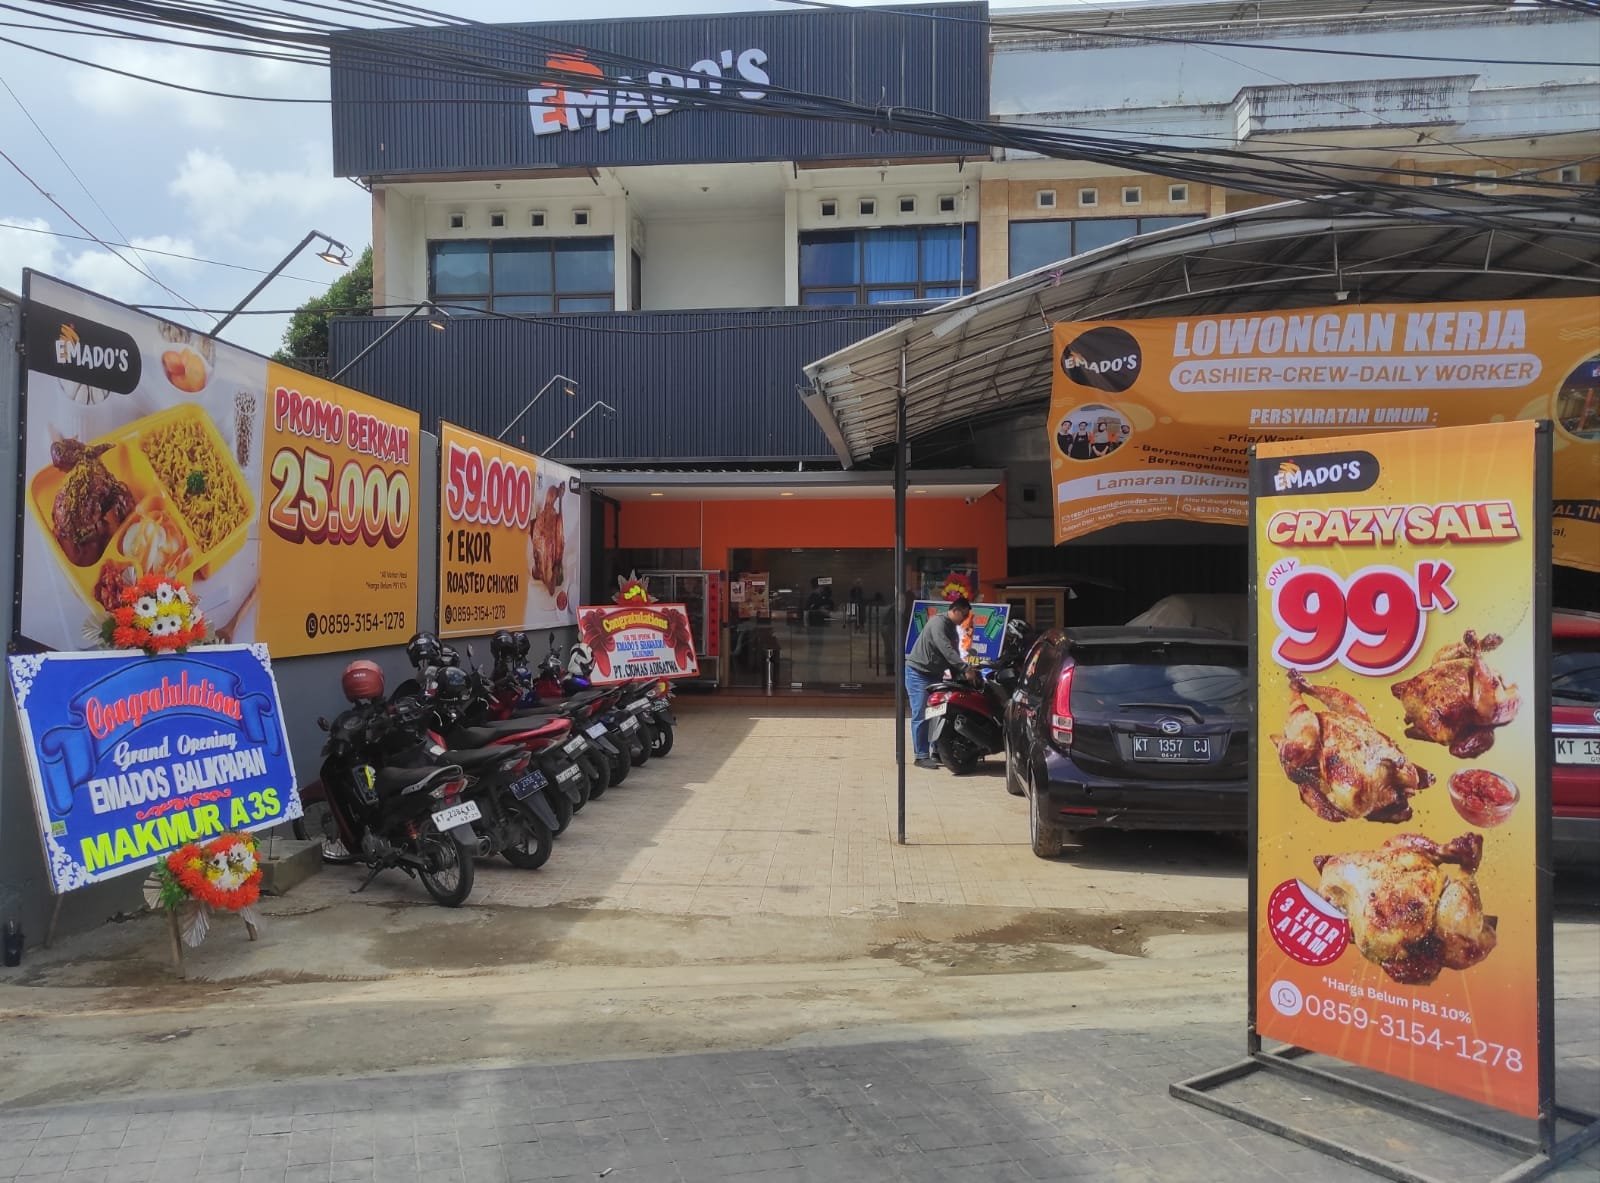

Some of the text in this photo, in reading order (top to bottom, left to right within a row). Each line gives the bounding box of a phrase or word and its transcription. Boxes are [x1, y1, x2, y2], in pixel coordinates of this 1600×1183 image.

[528, 48, 770, 136] EMADO'S
[1173, 309, 1526, 357] LOWONGAN KERJA
[55, 340, 129, 373] EMADO'S
[1065, 354, 1137, 374] EMADO'S
[1178, 361, 1534, 385] CASHIER-CREW-DAILY WORKER
[275, 387, 410, 464] PROMO BERKAH
[1250, 408, 1370, 425] PERSYARATAN
[1374, 408, 1429, 423] UMUM
[447, 441, 531, 529] 59.000
[1097, 472, 1247, 491] Lamaran Dikirim
[1273, 461, 1361, 491] EMADO'S
[268, 446, 411, 549] 25.000
[1552, 503, 1575, 516] AL
[1267, 500, 1521, 547] CRAZY SALE
[446, 530, 491, 565] 1 EKOR
[447, 571, 519, 595] ROASTED CHICKEN
[1269, 560, 1297, 587] ONLY
[319, 612, 405, 634] 0859-3154-1278
[452, 605, 506, 622] 0859-3154-1278
[602, 612, 668, 633] Congratulations
[1272, 561, 1459, 677] 99 K
[86, 671, 242, 739] Congratulations
[113, 730, 237, 771] Grand Opening
[1135, 739, 1208, 752] KT 1357 CJ
[1557, 740, 1575, 755] KT
[88, 748, 267, 814] EMADOS BALIKPAPAN
[80, 804, 224, 872] MAKMUR
[1276, 915, 1328, 956] AYAM
[1279, 897, 1340, 945] 3 EKOR
[1367, 987, 1409, 1008] Belum
[1412, 999, 1436, 1016] PB1
[1441, 1005, 1472, 1024] 10%
[1305, 995, 1524, 1073] 0859-3154-1278
